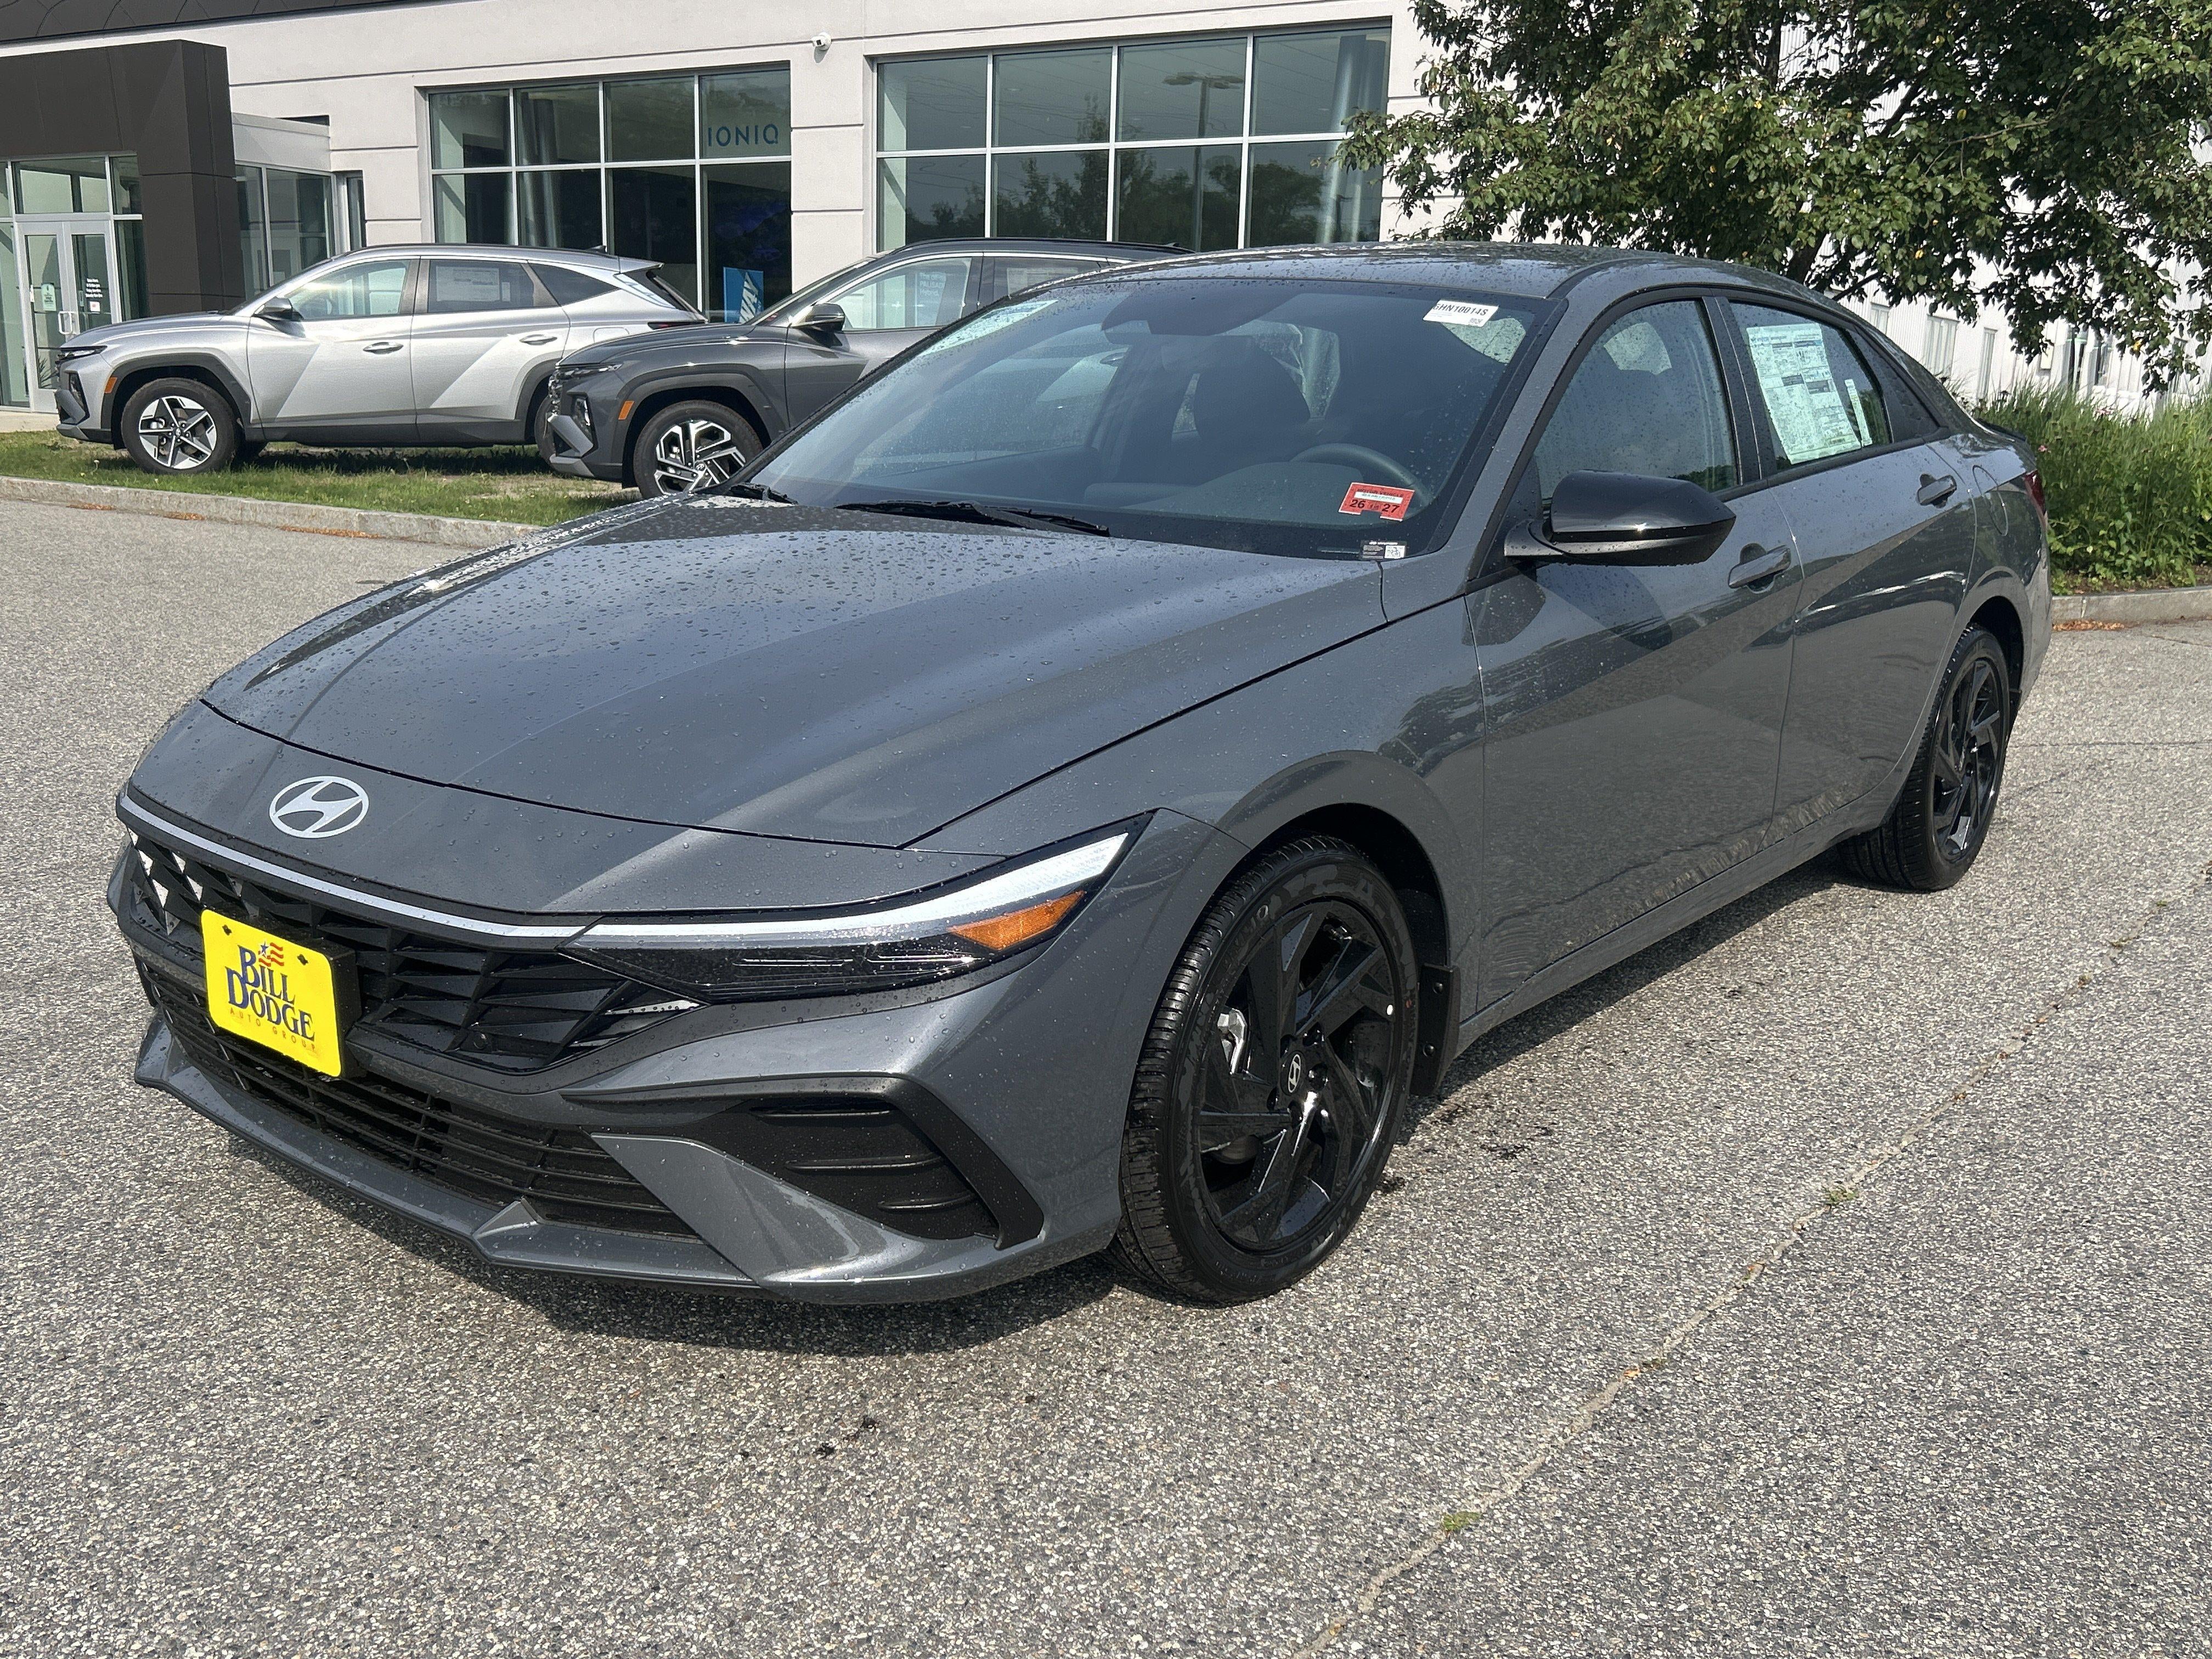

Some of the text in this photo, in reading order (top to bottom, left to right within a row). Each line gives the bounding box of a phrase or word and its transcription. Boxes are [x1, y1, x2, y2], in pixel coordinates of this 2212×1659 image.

[708, 123, 778, 146] IONIQ
[1350, 499, 1365, 509] 26
[1381, 503, 1400, 514] 27
[238, 945, 295, 1004] BILL
[225, 966, 315, 1041] DODGE
[230, 1008, 317, 1052] AUTO GROUP
